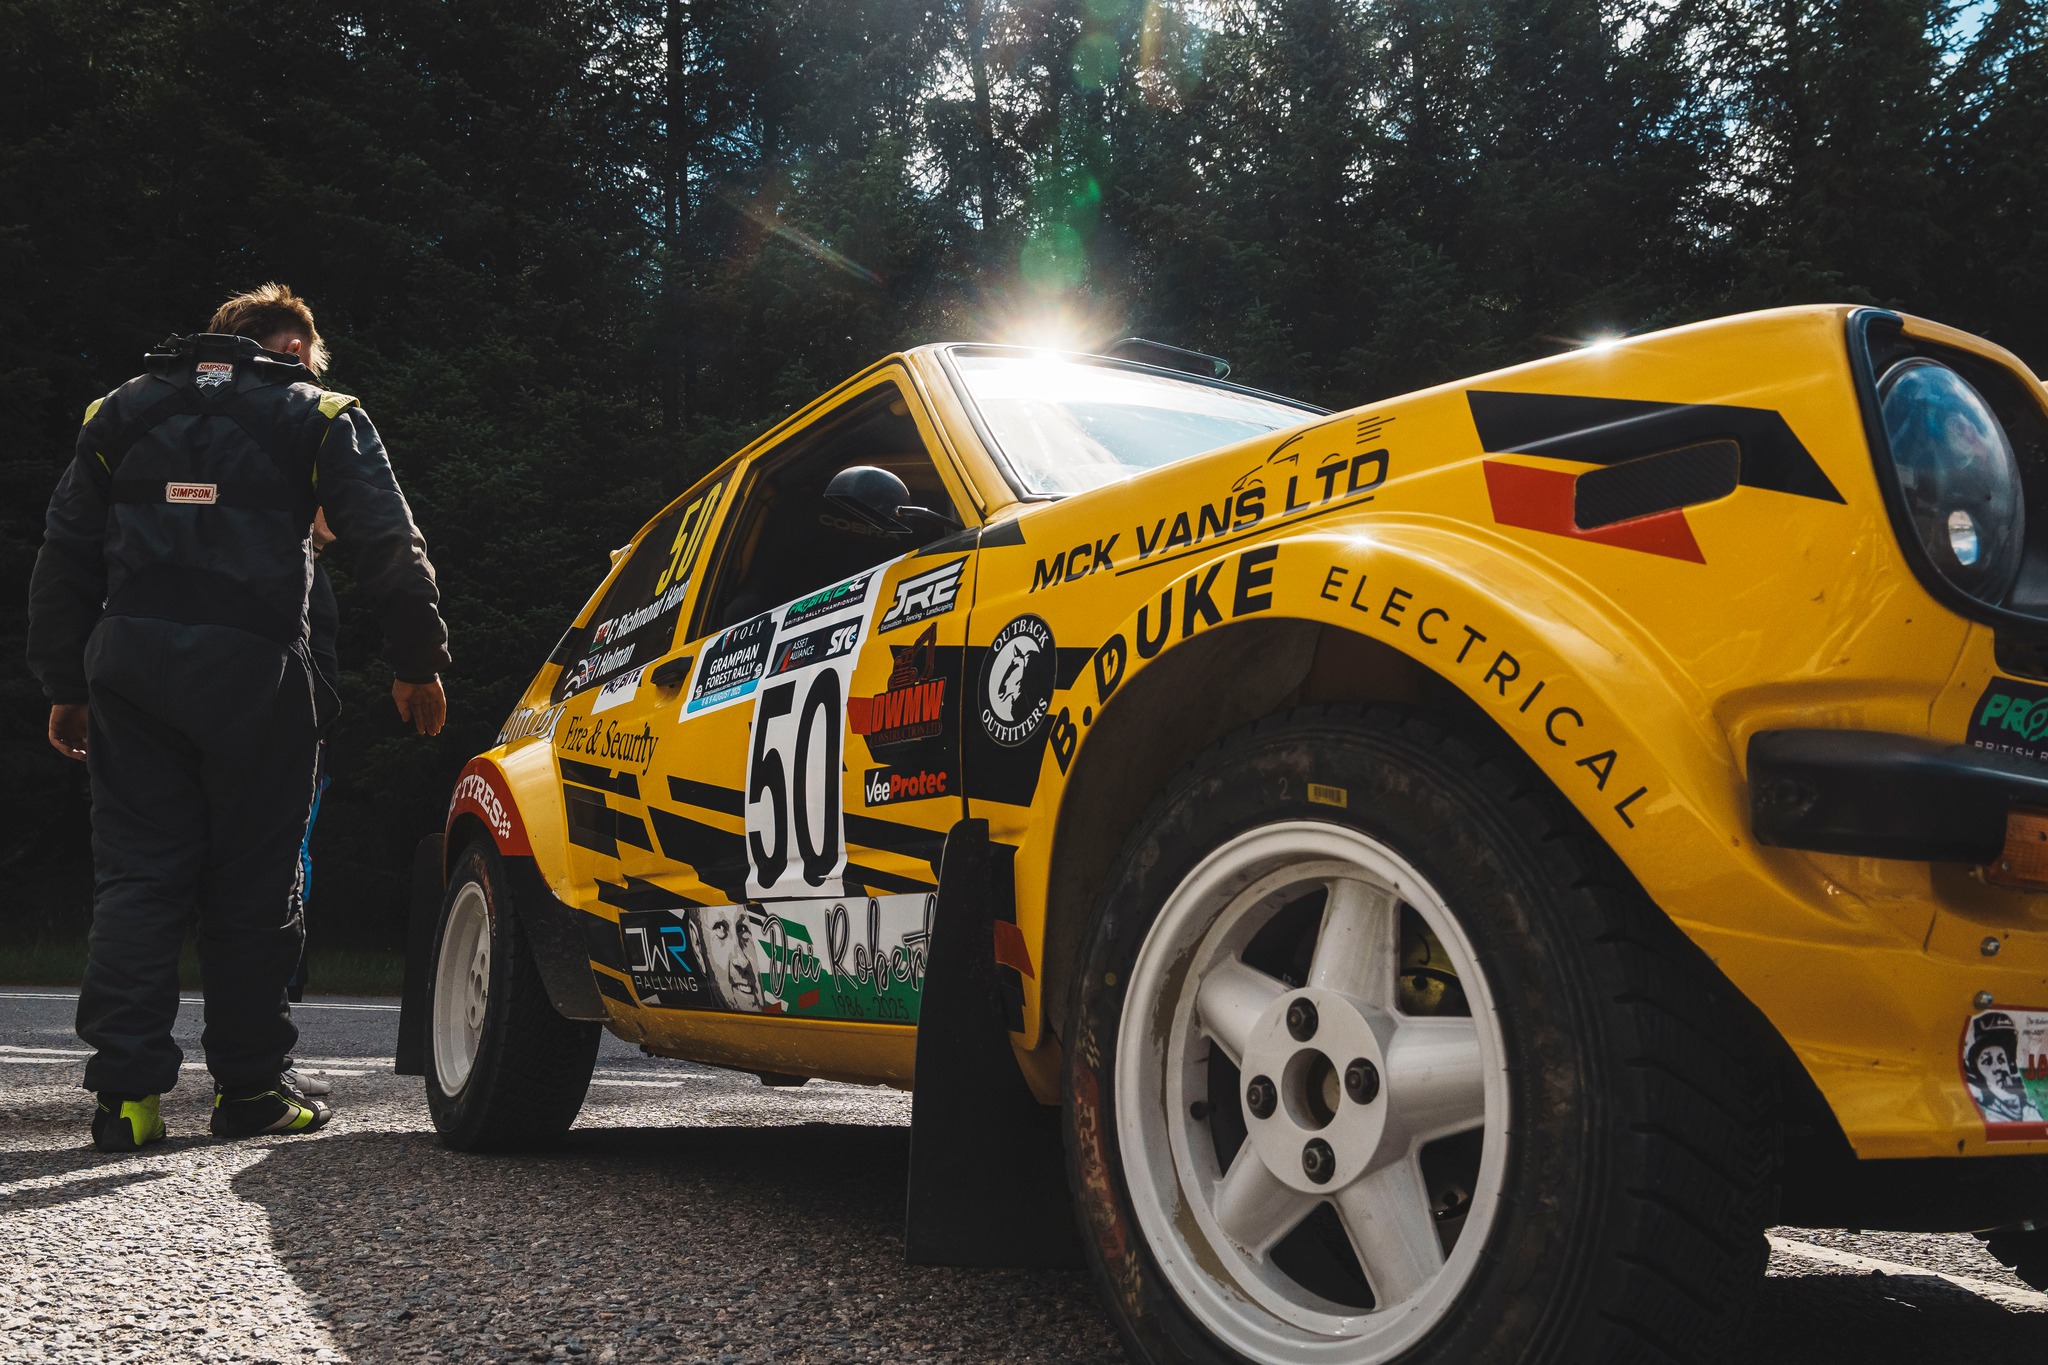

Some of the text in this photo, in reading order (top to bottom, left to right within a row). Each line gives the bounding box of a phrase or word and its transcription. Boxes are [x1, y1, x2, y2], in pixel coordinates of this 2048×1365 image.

[171, 488, 211, 498] SIMPSON
[1029, 448, 1390, 593] MCK VANS LTD
[655, 482, 723, 597] 50
[883, 561, 964, 623] JRE
[606, 618, 619, 645] C
[613, 591, 668, 640] Richmond
[784, 594, 863, 627] BRITISH RALLY CHAMPIONSHIP
[880, 602, 954, 632] Excavation Fencing Landscaping
[789, 645, 815, 660] ALLIANCE
[792, 637, 809, 649] ASSET
[993, 619, 1049, 652] OUTBACK
[595, 643, 636, 678] Holman
[705, 670, 733, 690] FOREST
[731, 661, 756, 680] RALLY
[709, 643, 760, 675] GRAMPIAN
[871, 680, 945, 733] DWMW
[1320, 566, 1648, 829] ELECTRICAL
[982, 698, 1048, 742] OUTFITTERS
[561, 716, 588, 750] Fire
[585, 719, 603, 755] &
[601, 720, 659, 776] Security
[748, 667, 841, 889] 50
[866, 770, 947, 803] VeeProtec
[461, 774, 503, 828] TYRES
[635, 974, 699, 993] RALLYING
[831, 994, 864, 1016] 1986
[872, 996, 910, 1019] 2025
